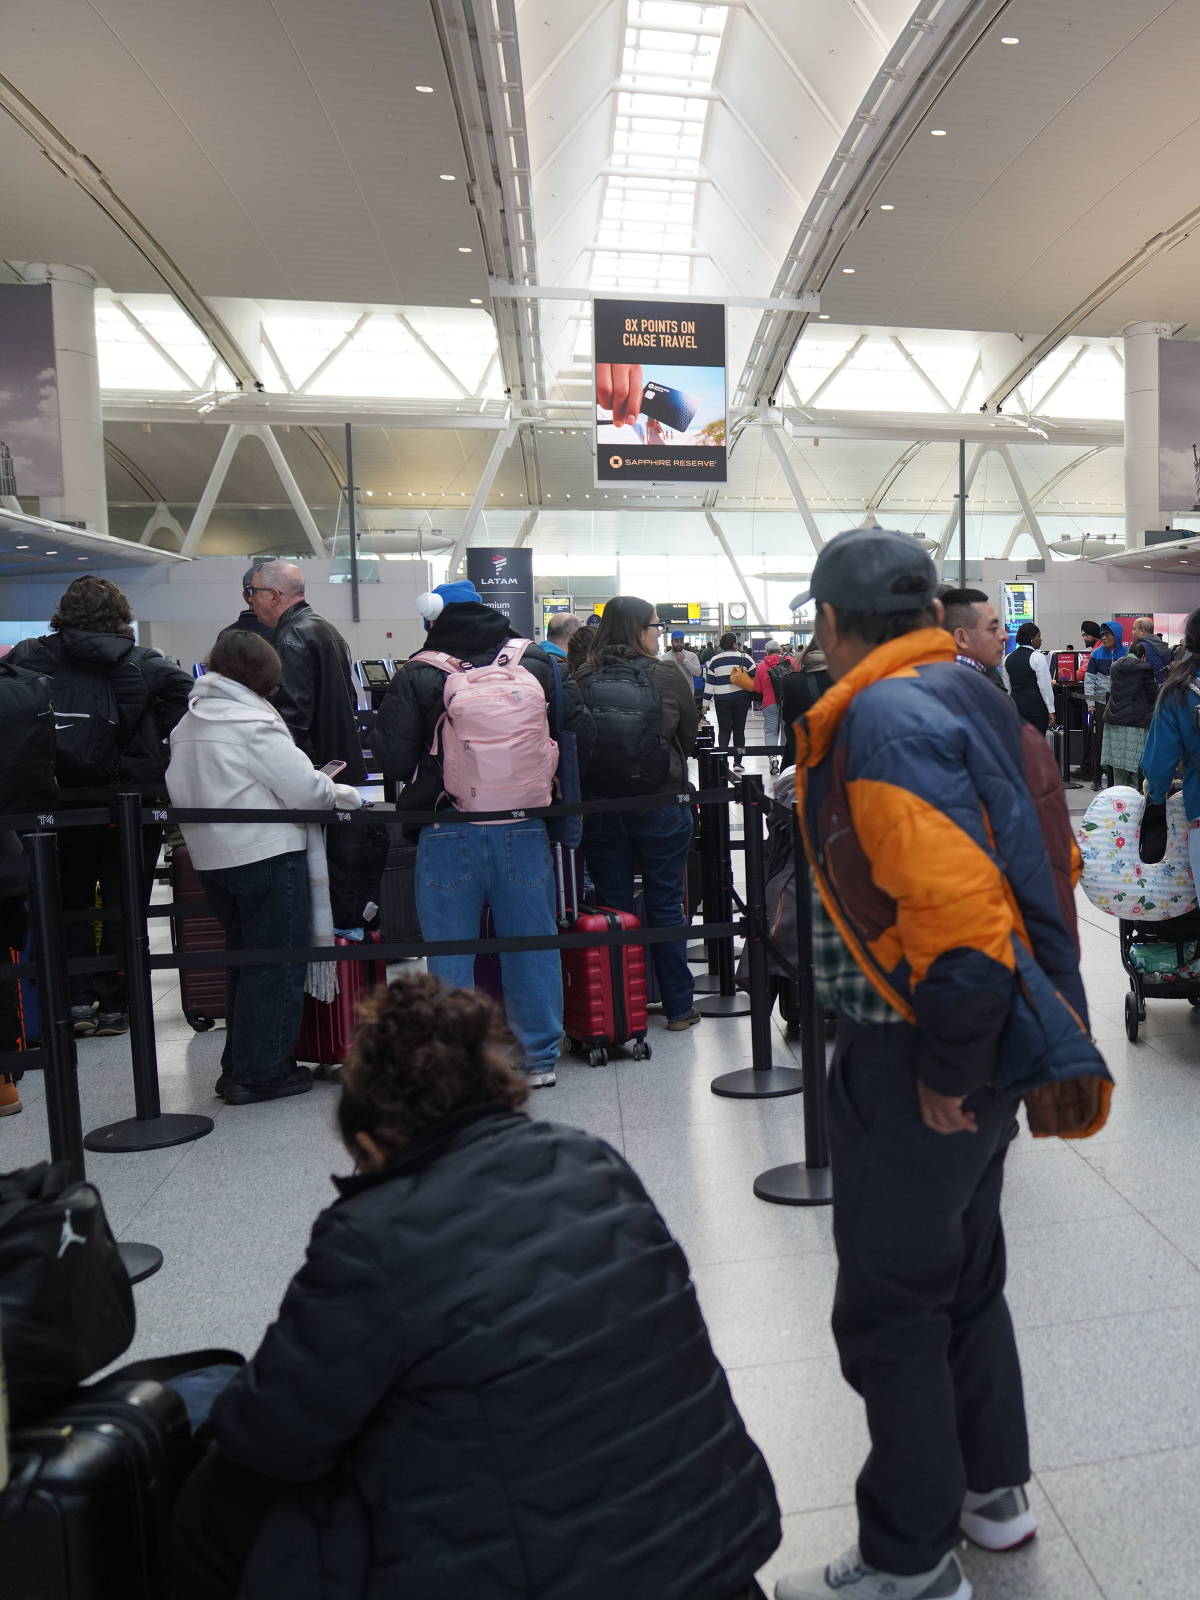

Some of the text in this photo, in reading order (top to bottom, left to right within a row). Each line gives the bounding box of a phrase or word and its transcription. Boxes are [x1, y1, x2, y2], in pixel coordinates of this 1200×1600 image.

[625, 318, 696, 334] 8X POINTS ON
[623, 334, 698, 348] CHASE TRAVEL
[677, 794, 690, 803] T4
[37, 814, 54, 826] T4
[152, 810, 168, 821] T4
[337, 812, 351, 821] T4
